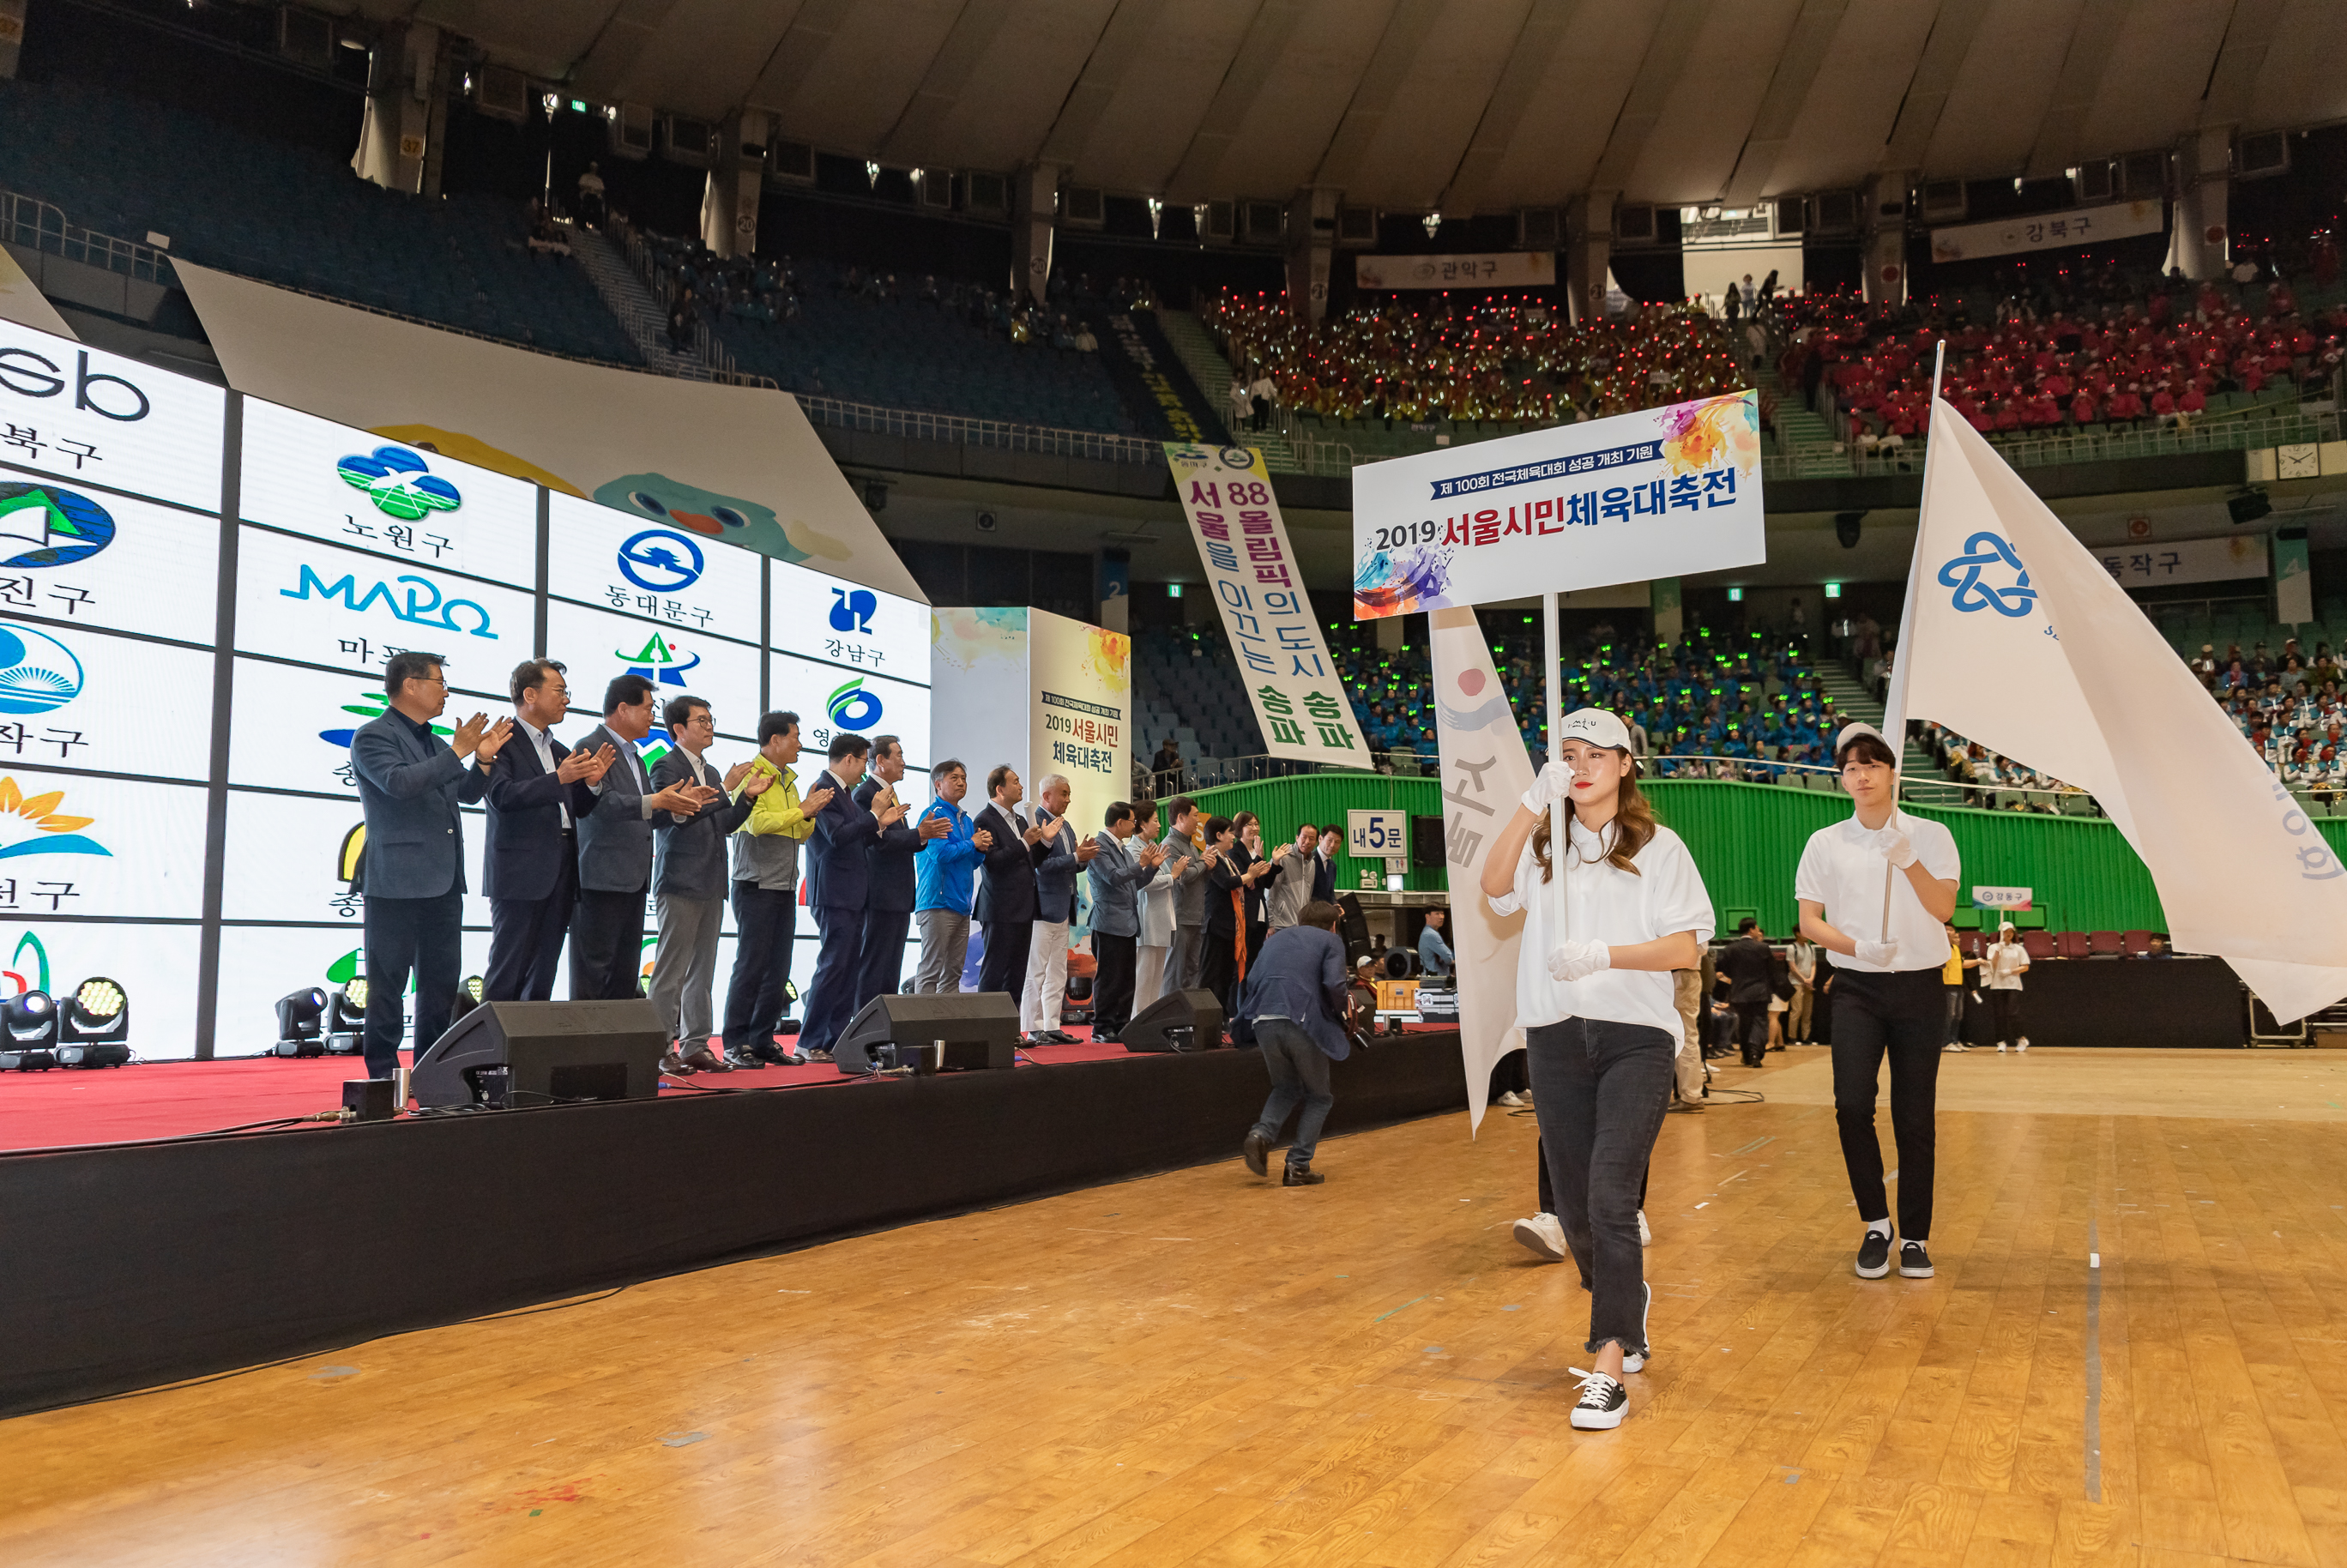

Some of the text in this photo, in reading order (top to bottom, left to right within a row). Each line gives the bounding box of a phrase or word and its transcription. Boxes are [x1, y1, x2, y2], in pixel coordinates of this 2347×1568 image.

[2025, 216, 2092, 244] 강북구
[1441, 261, 1499, 280] 관악구
[1440, 444, 1653, 495] 제 100회 전국체육대회 성공 개최 기원
[342, 514, 454, 558] 노원구
[1375, 520, 1436, 551] 2019
[2103, 552, 2182, 579] 동작구
[280, 564, 499, 640] MAPO
[604, 584, 715, 628] 동대문구
[1107, 581, 1121, 600] 2
[1190, 480, 1240, 573] 서울을
[1256, 684, 1306, 746] 송파
[824, 638, 886, 667] 강남구
[1276, 625, 1325, 678] 도시
[1302, 691, 1355, 751] 송파
[1045, 714, 1119, 748] 2019 서울시민
[1053, 740, 1113, 774] 체육대축전
